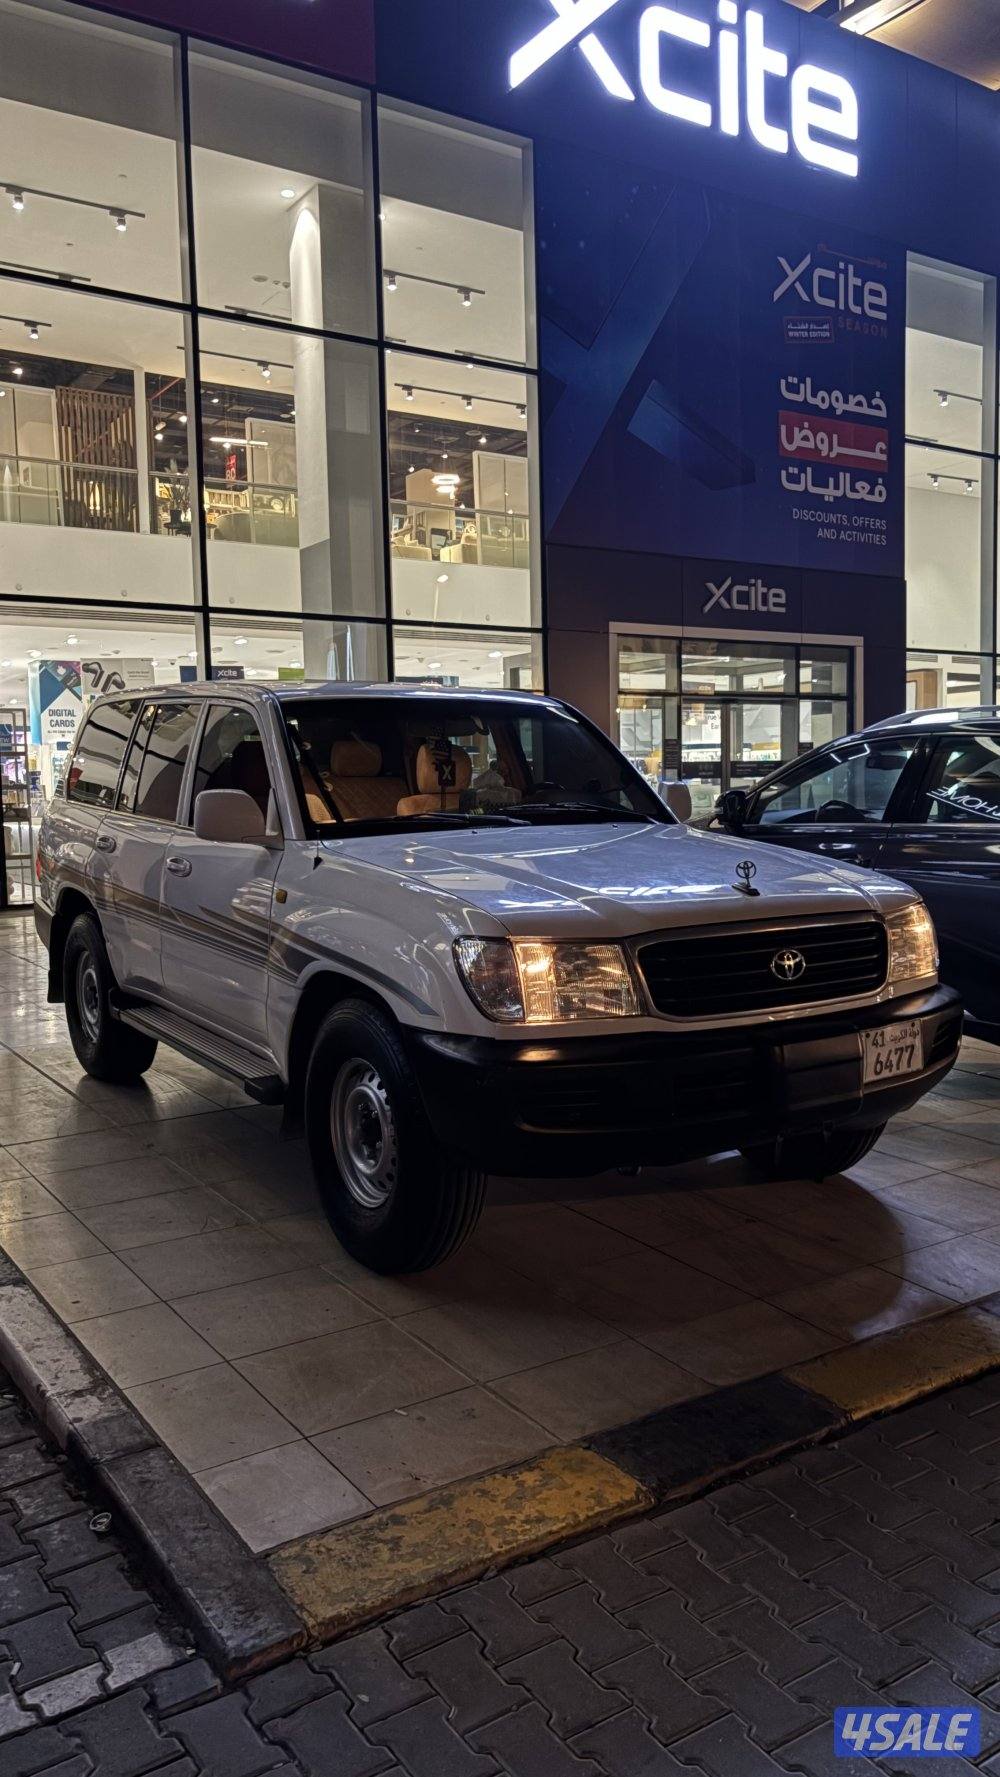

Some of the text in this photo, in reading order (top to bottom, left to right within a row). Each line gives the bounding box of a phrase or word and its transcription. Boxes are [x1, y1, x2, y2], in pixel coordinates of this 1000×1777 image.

[508, 0, 859, 178] Xcite
[773, 252, 888, 321] Xcite
[780, 375, 887, 419] خصومات
[780, 421, 887, 461] عروض
[780, 466, 887, 503] فعاليات
[792, 508, 887, 530] DISCOUNTS, OFFERS
[817, 528, 887, 546] AND ACTIVITIES
[703, 576, 786, 614] Xcite
[217, 668, 238, 677] Xcite
[48, 708, 77, 718] DIGITAL
[49, 719, 75, 728] CARDS
[872, 1030, 885, 1048] 41
[874, 1044, 915, 1076] 6477
